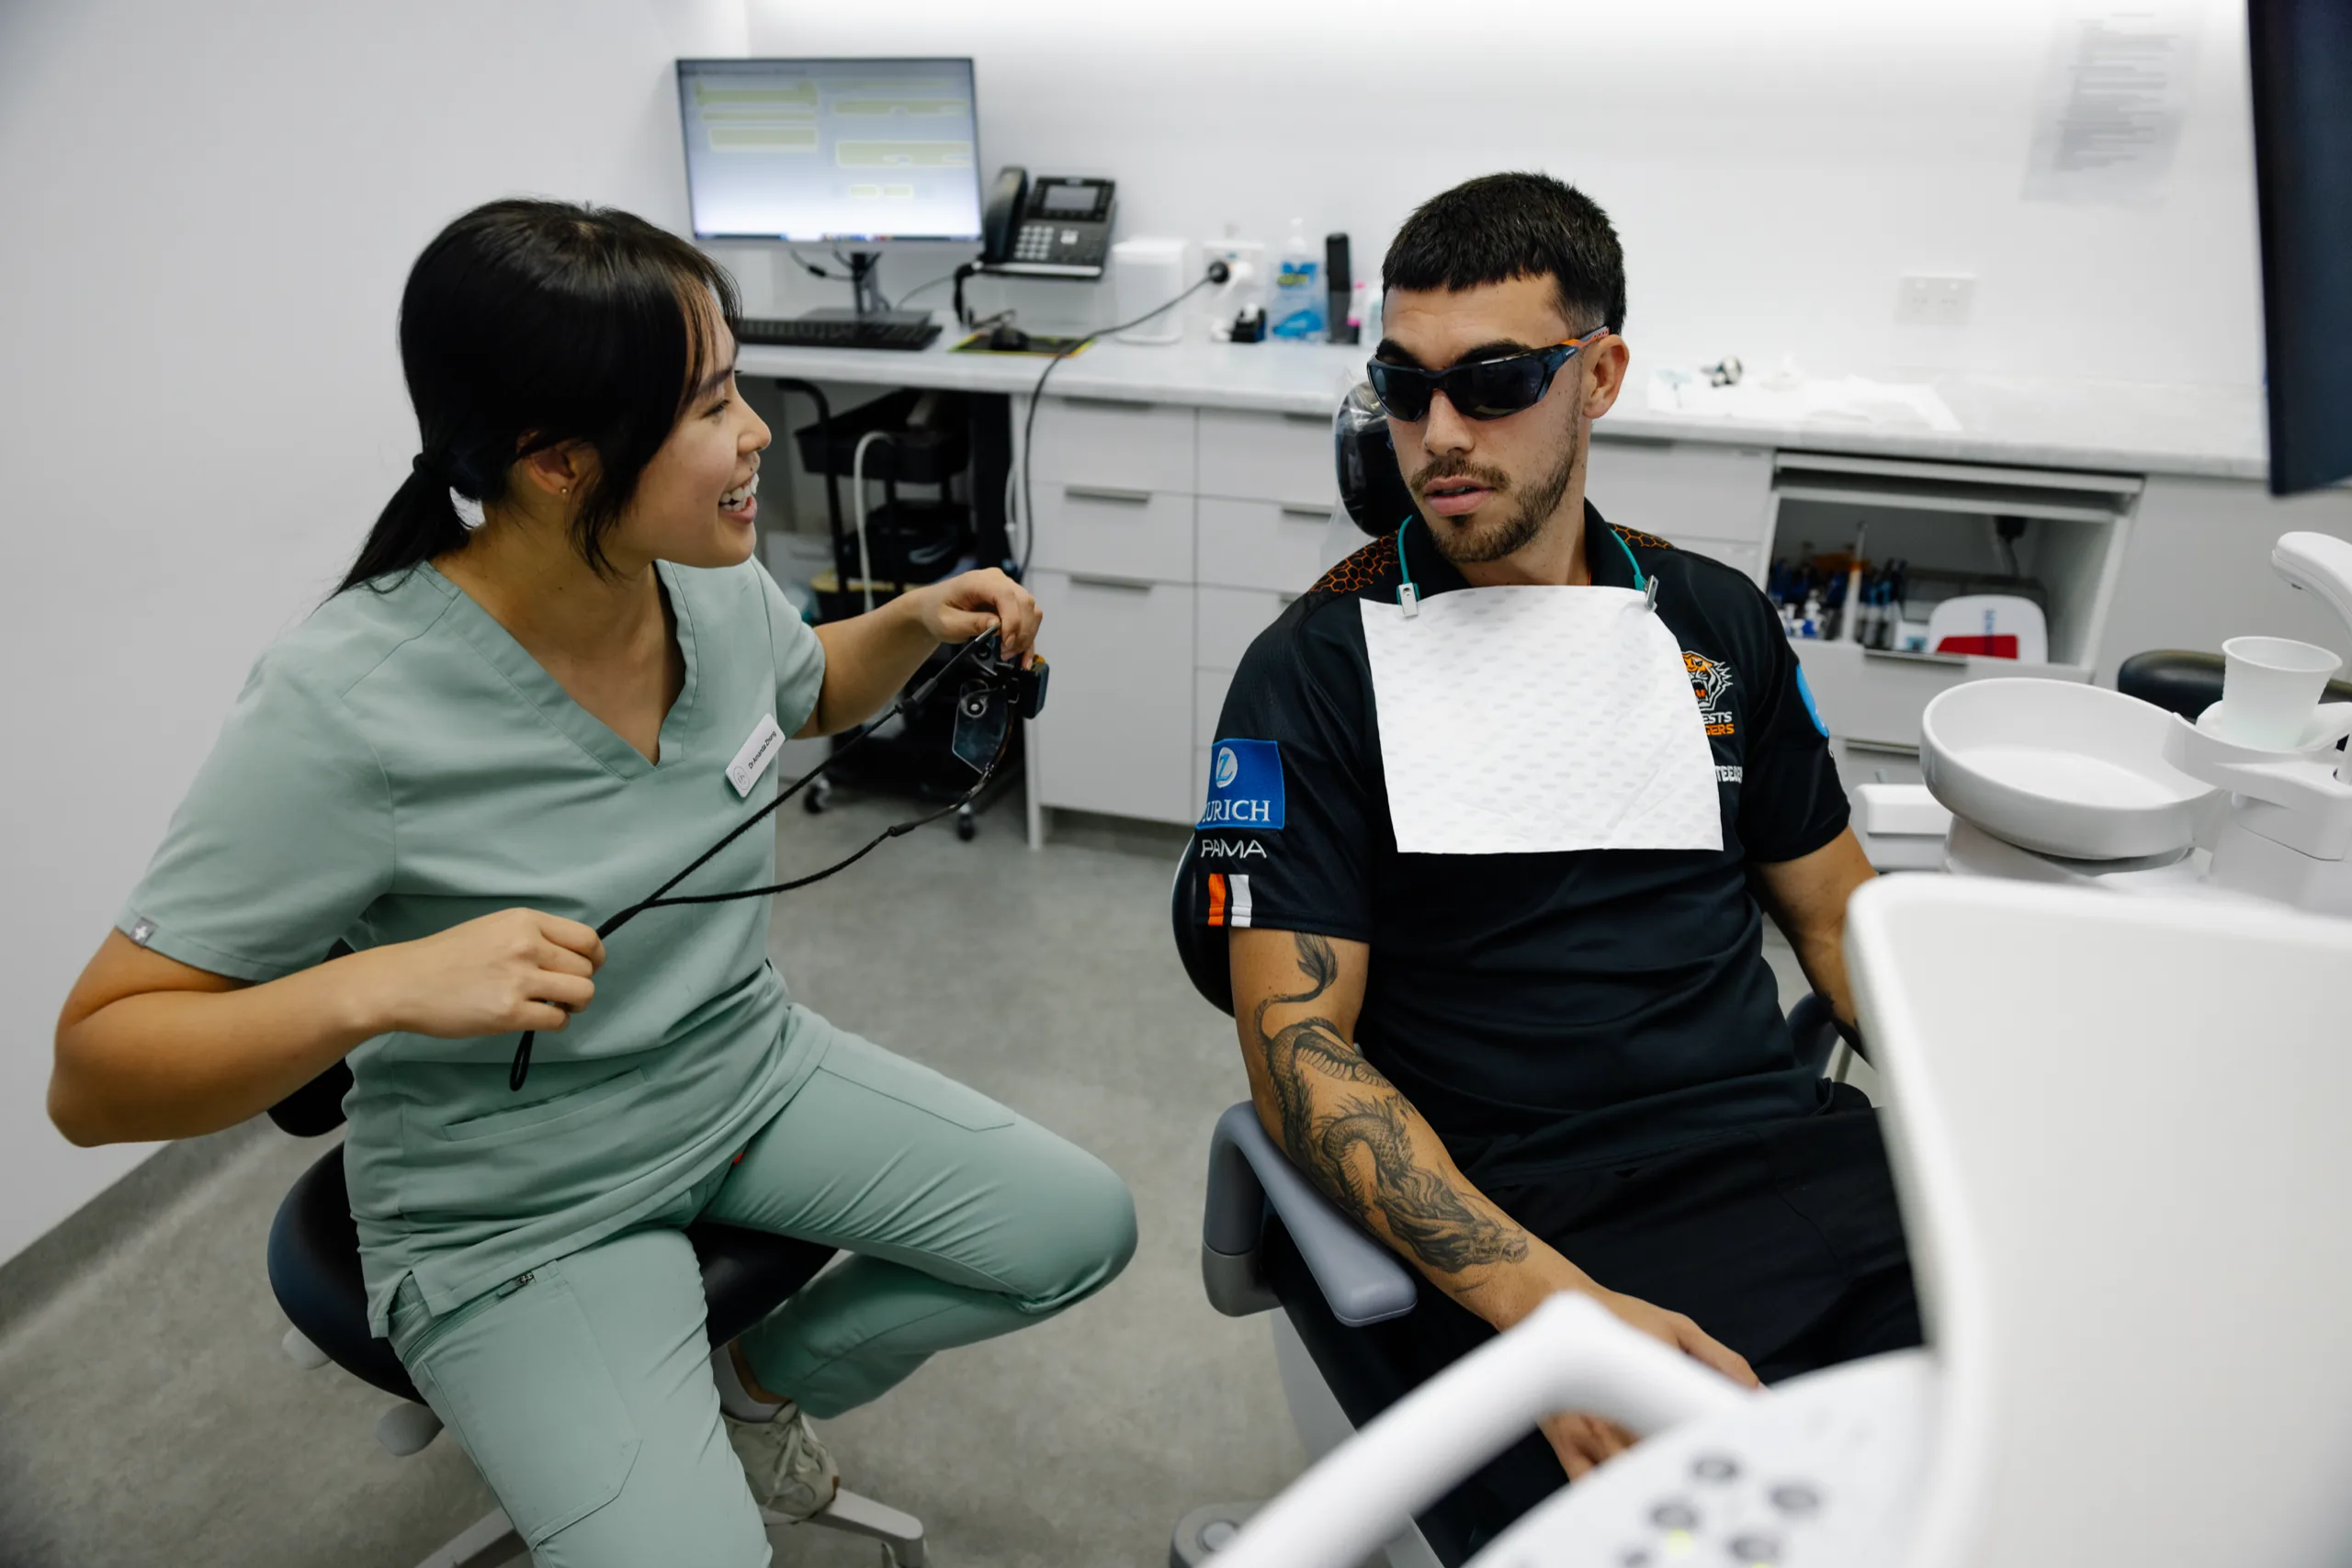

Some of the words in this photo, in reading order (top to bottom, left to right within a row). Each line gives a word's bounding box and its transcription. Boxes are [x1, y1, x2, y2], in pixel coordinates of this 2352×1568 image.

[1702, 711, 1732, 723] ESTS
[1705, 724, 1735, 735] GERS
[1202, 799, 1270, 822] URICH
[1200, 838, 1267, 859] PAMA
